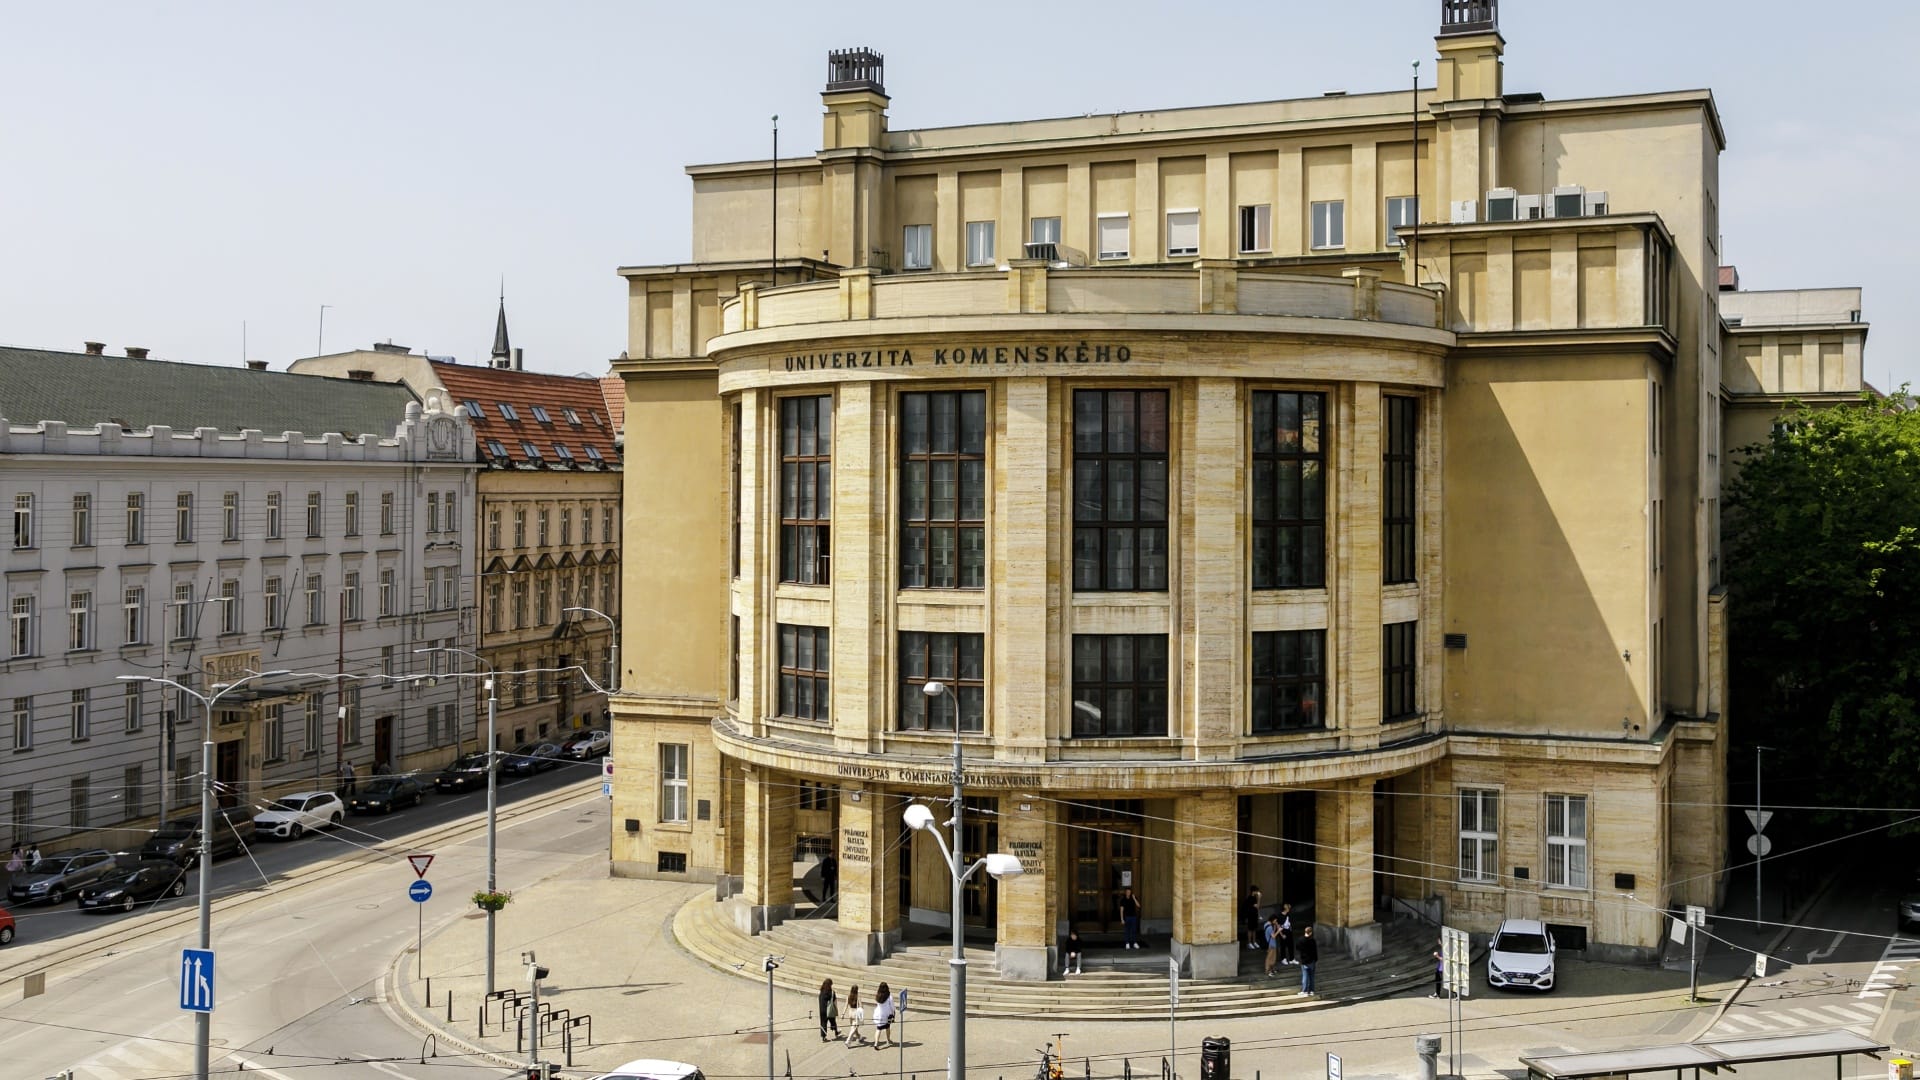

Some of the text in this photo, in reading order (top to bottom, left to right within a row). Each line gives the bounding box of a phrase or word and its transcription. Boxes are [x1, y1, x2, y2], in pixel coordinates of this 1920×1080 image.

[785, 340, 1131, 372] UNIVERZITA KOMENSKÉHO
[837, 765, 890, 780] UNIVERSITAS
[963, 774, 1043, 786] BRATISLAVENSIS
